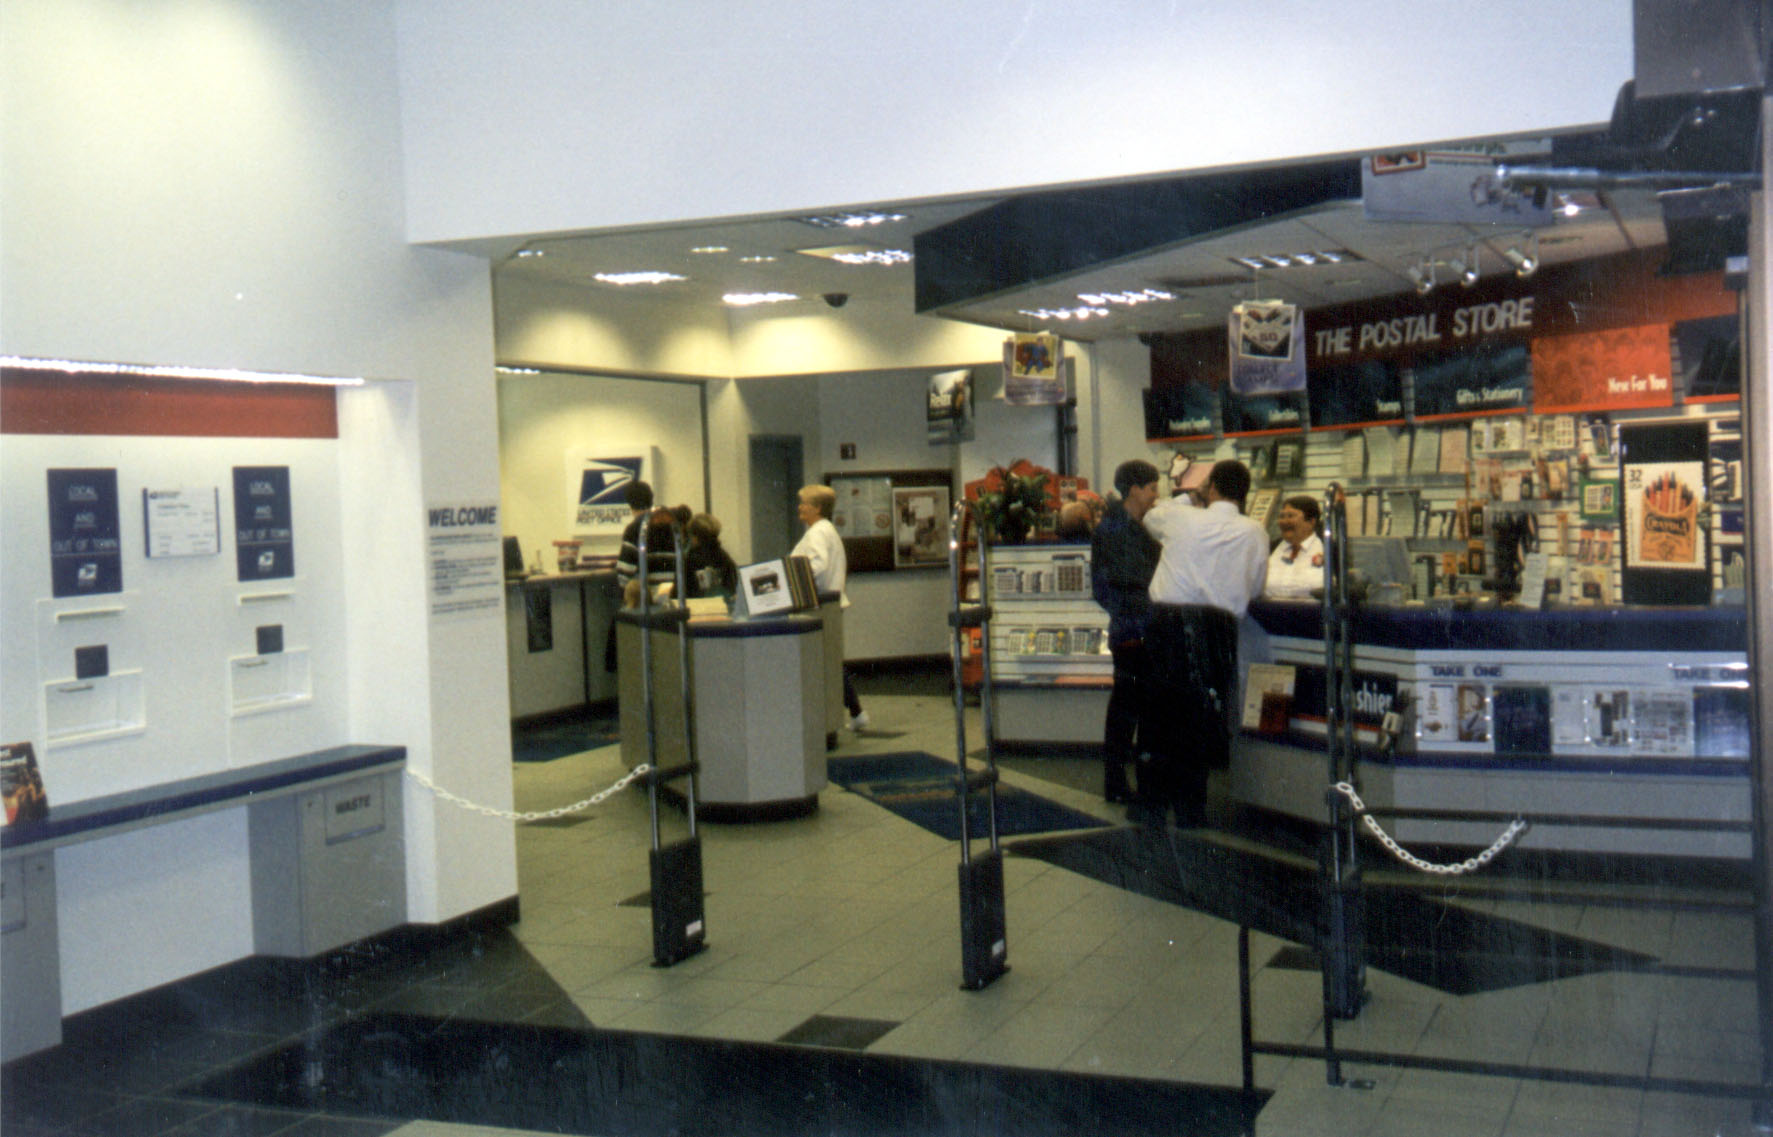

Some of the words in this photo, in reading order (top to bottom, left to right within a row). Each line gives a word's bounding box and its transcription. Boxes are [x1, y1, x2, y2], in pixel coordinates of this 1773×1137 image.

[1315, 327, 1352, 355] THE
[1359, 313, 1441, 350] POSTAL
[1452, 297, 1534, 337] STORE
[1631, 375, 1647, 391] For
[1648, 373, 1667, 391] You
[1629, 469, 1643, 482] 32
[68, 485, 98, 500] LOCAL
[74, 512, 96, 528] AND
[428, 506, 497, 528] WELCOME
[1431, 665, 1465, 678] TAKE
[1473, 665, 1502, 678] ONE
[1674, 667, 1711, 681] TAKE
[1341, 678, 1393, 716] shier
[335, 794, 371, 815] WASTE
